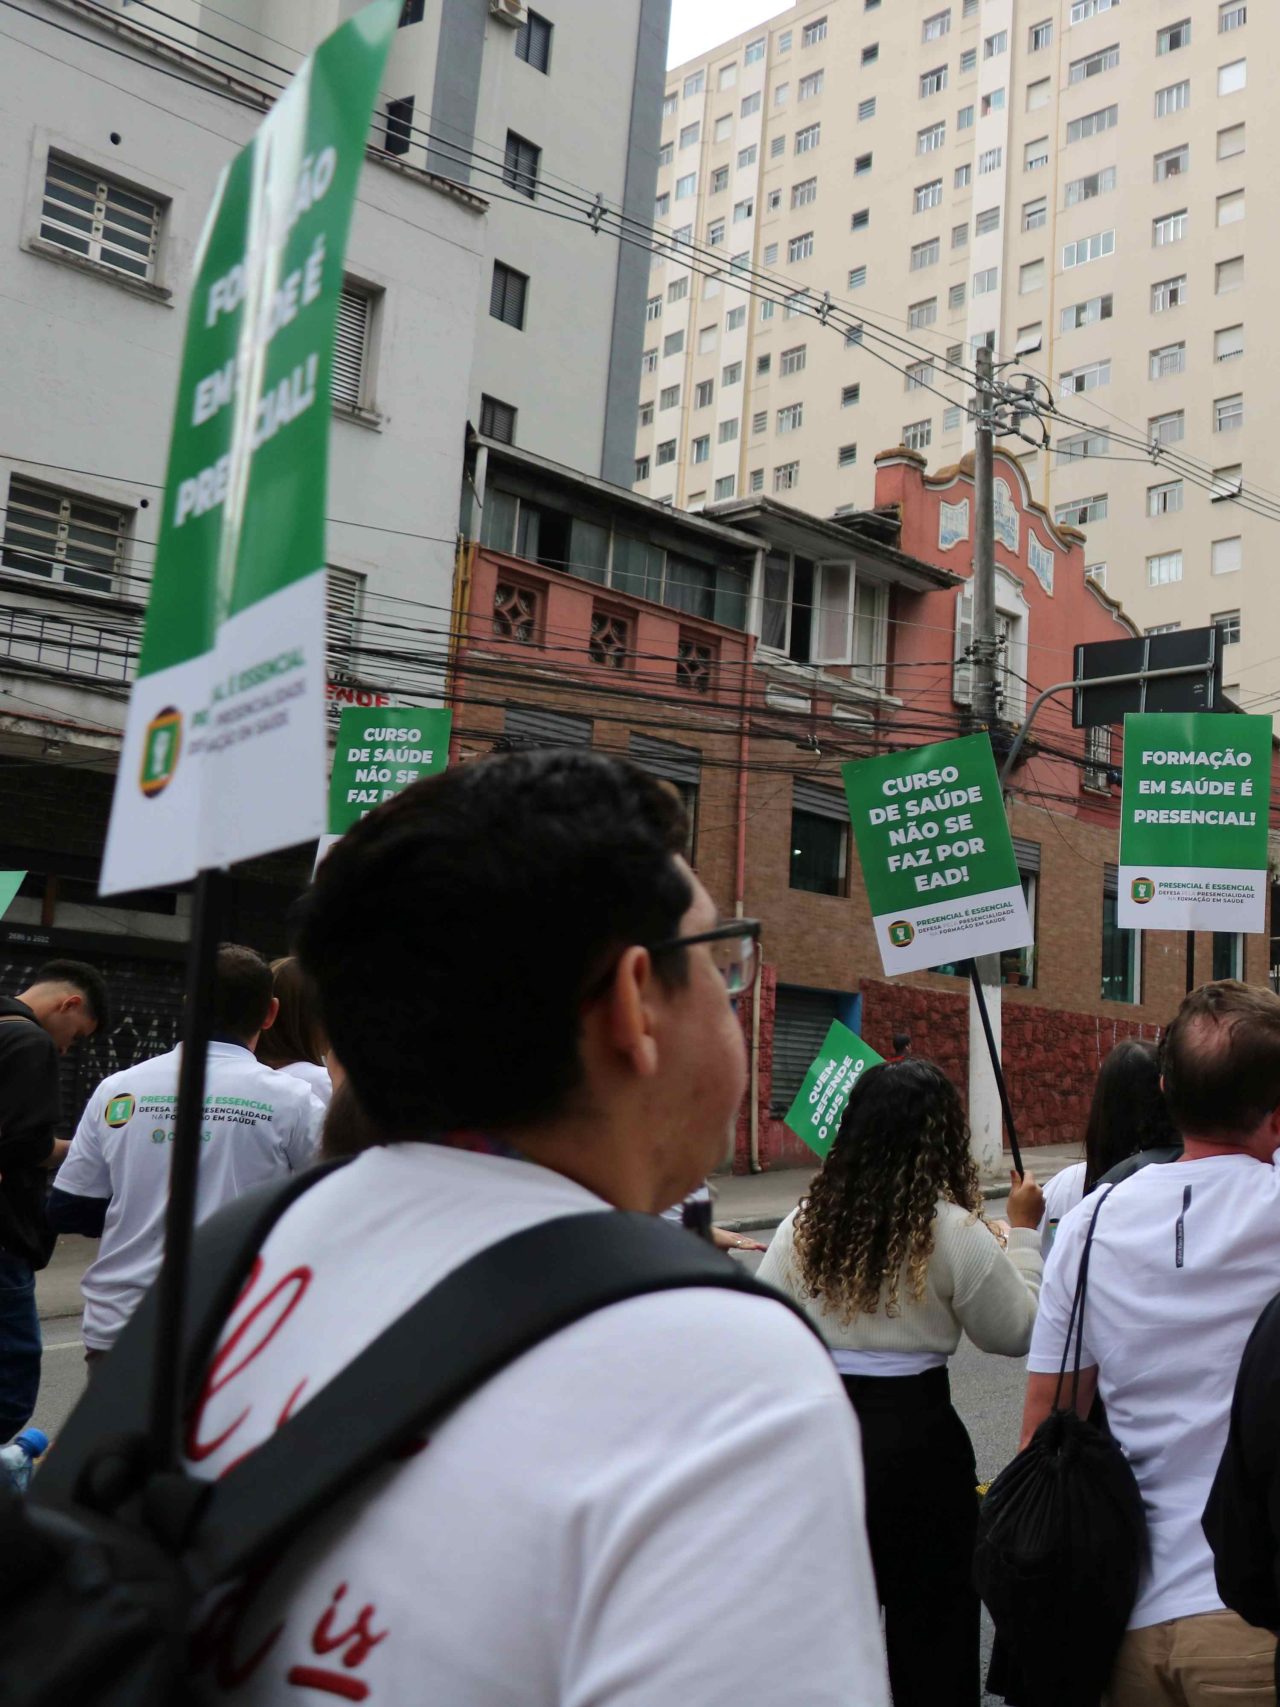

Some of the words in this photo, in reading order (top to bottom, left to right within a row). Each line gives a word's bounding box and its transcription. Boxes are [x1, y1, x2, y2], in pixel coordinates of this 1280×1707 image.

[325, 684, 389, 707] ENDE
[364, 728, 421, 742] CURSO
[348, 749, 370, 762] DE
[373, 746, 433, 763] SAÚDE
[1143, 748, 1251, 769] FORMAÇÃO
[355, 765, 391, 782] NÃO
[396, 770, 419, 783] SE
[883, 766, 958, 796] CURSO
[347, 790, 378, 802] FAZ
[1139, 781, 1166, 794] EM
[1171, 778, 1235, 795] SAÚDE
[1241, 779, 1253, 796] É
[869, 804, 901, 825] DE
[905, 786, 982, 817] SAÚDE
[1134, 810, 1256, 826] PRESENCIAL!
[889, 821, 939, 846] NÃO
[945, 814, 973, 833] SE
[888, 850, 932, 872] FAZ
[937, 838, 986, 861] POR
[915, 866, 969, 892] EAD!
[917, 911, 964, 926] PRESENCIAL
[971, 902, 1013, 915] ESSENCIAL
[919, 925, 941, 933] DEFESA
[959, 909, 1014, 924] PRESENCIALIDADE
[940, 923, 973, 935] FORMAÇÃO
[986, 917, 1006, 925] SAÚDE
[809, 1059, 837, 1104] QUEM
[811, 1056, 853, 1126] DEFENDE
[206, 1095, 213, 1104] É
[216, 1097, 274, 1112] ESSENCIAL
[819, 1126, 827, 1139] O
[825, 1093, 843, 1125] SUS
[841, 1059, 864, 1093] NÃO
[202, 1107, 272, 1121] ESENCIALIDADE
[227, 1116, 256, 1126] SAÚDE
